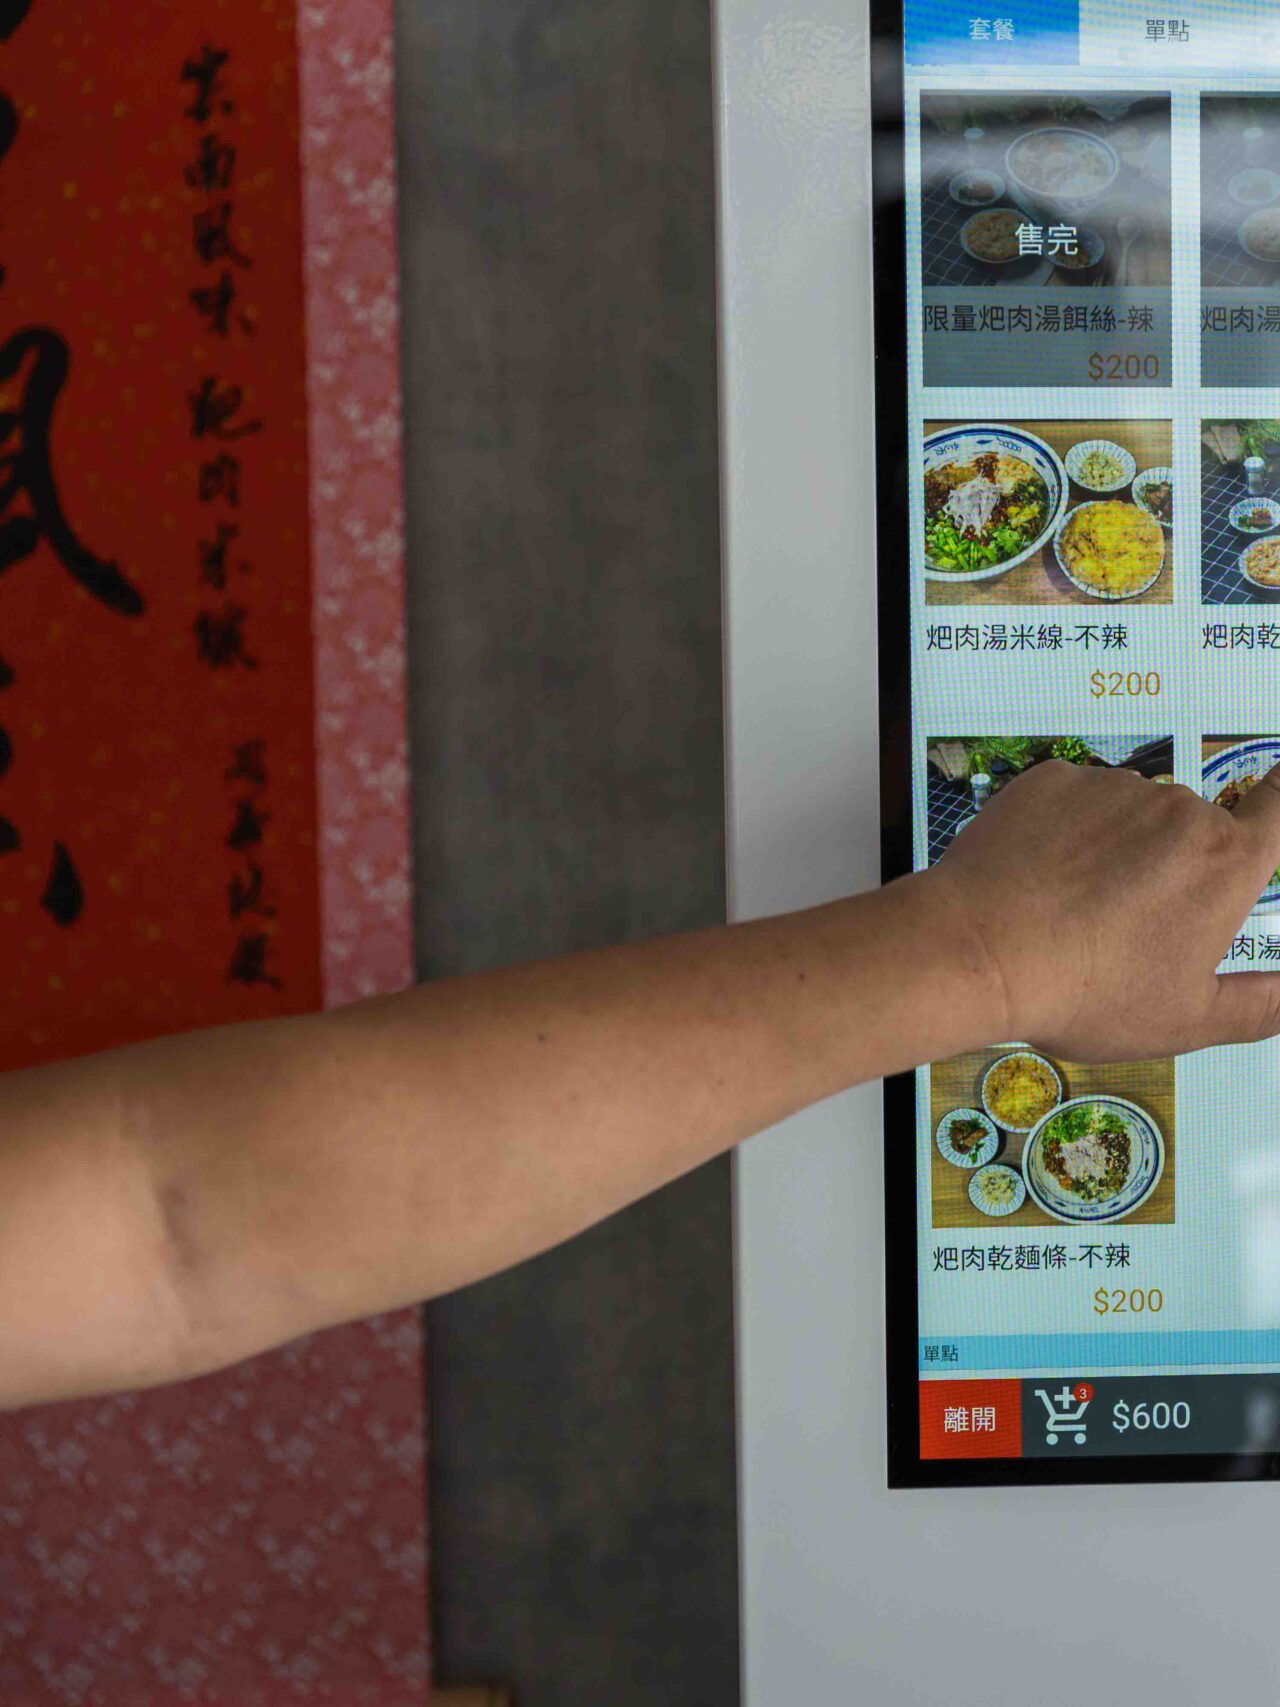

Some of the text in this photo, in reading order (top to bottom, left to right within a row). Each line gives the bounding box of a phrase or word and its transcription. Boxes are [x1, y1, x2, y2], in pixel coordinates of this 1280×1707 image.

[969, 18, 1014, 41] 套餐
[1145, 19, 1190, 42] 單點
[1015, 223, 1078, 256] 售完
[1088, 352, 1160, 382] $200
[1090, 668, 1162, 698] $200
[1093, 1287, 1164, 1316] $200
[923, 1344, 959, 1363] 單點
[1079, 1388, 1087, 1399] 3
[943, 1406, 996, 1433] 離開
[1112, 1399, 1191, 1433] $600
